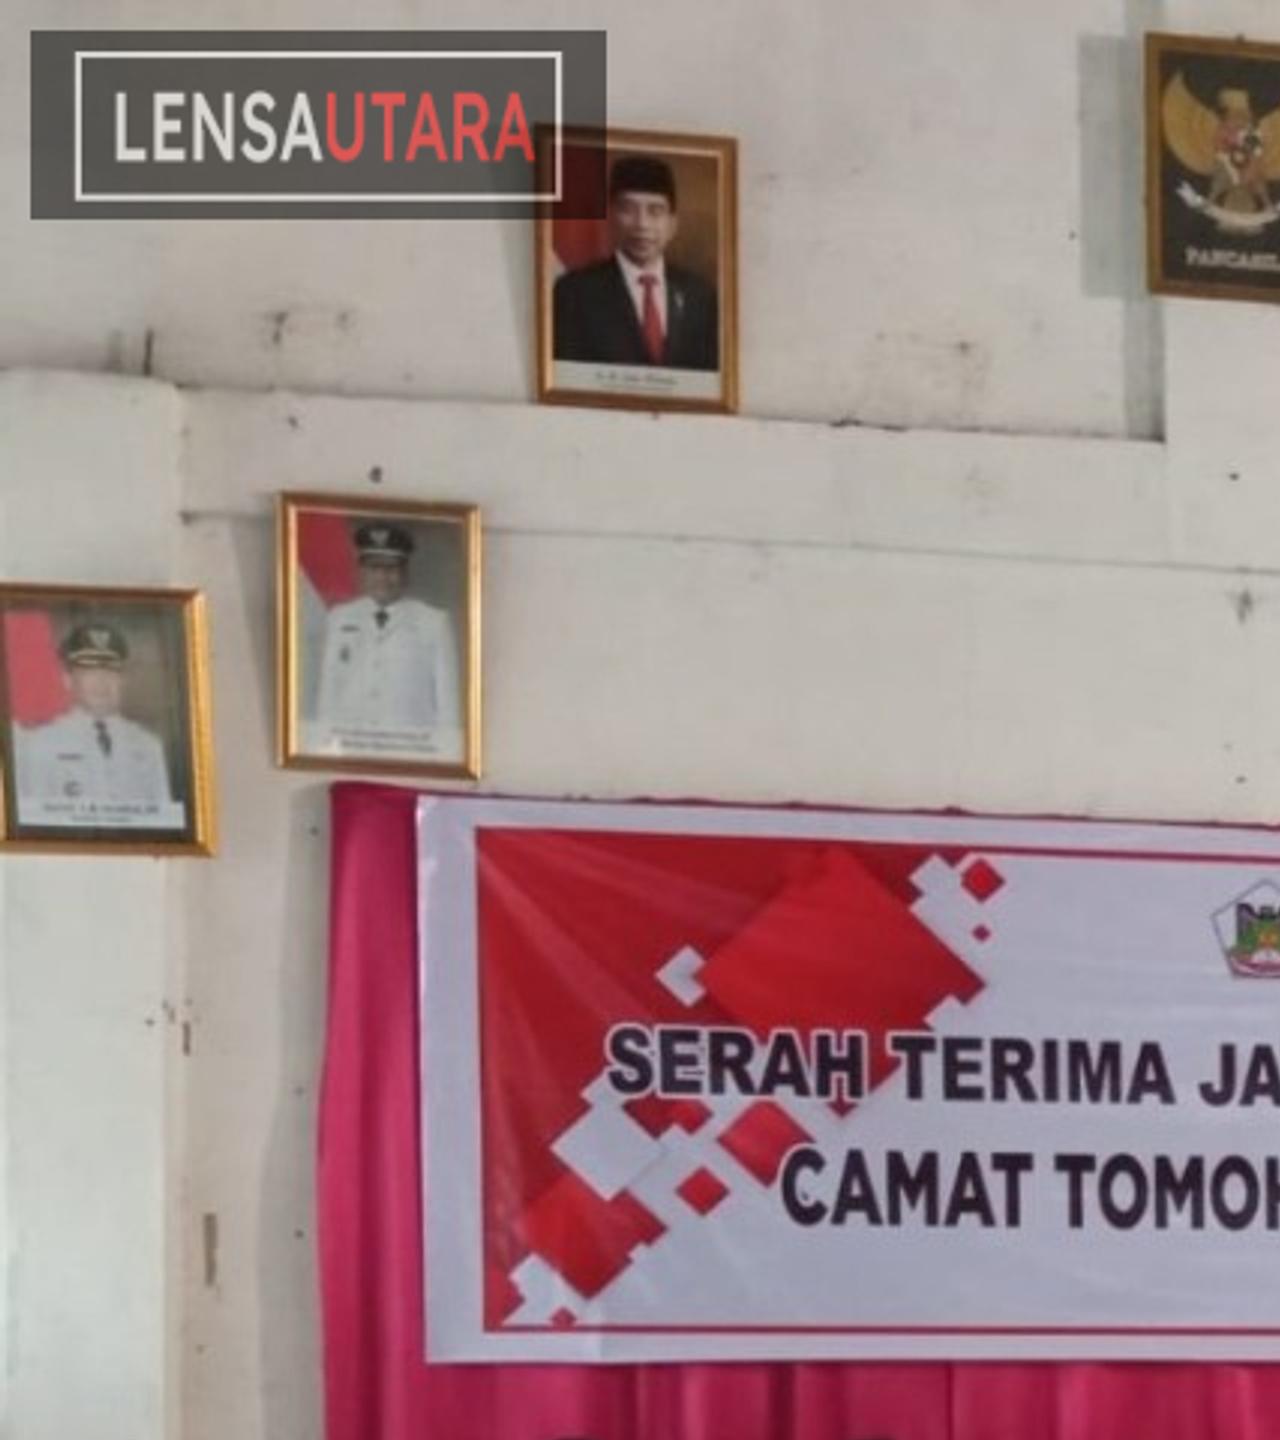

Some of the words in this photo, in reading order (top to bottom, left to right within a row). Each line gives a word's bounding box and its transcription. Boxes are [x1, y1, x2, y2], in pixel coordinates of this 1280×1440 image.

[607, 1028, 867, 1099] SERAH
[892, 1036, 1177, 1105] TERIMA
[781, 1148, 1035, 1227] CAMAT
